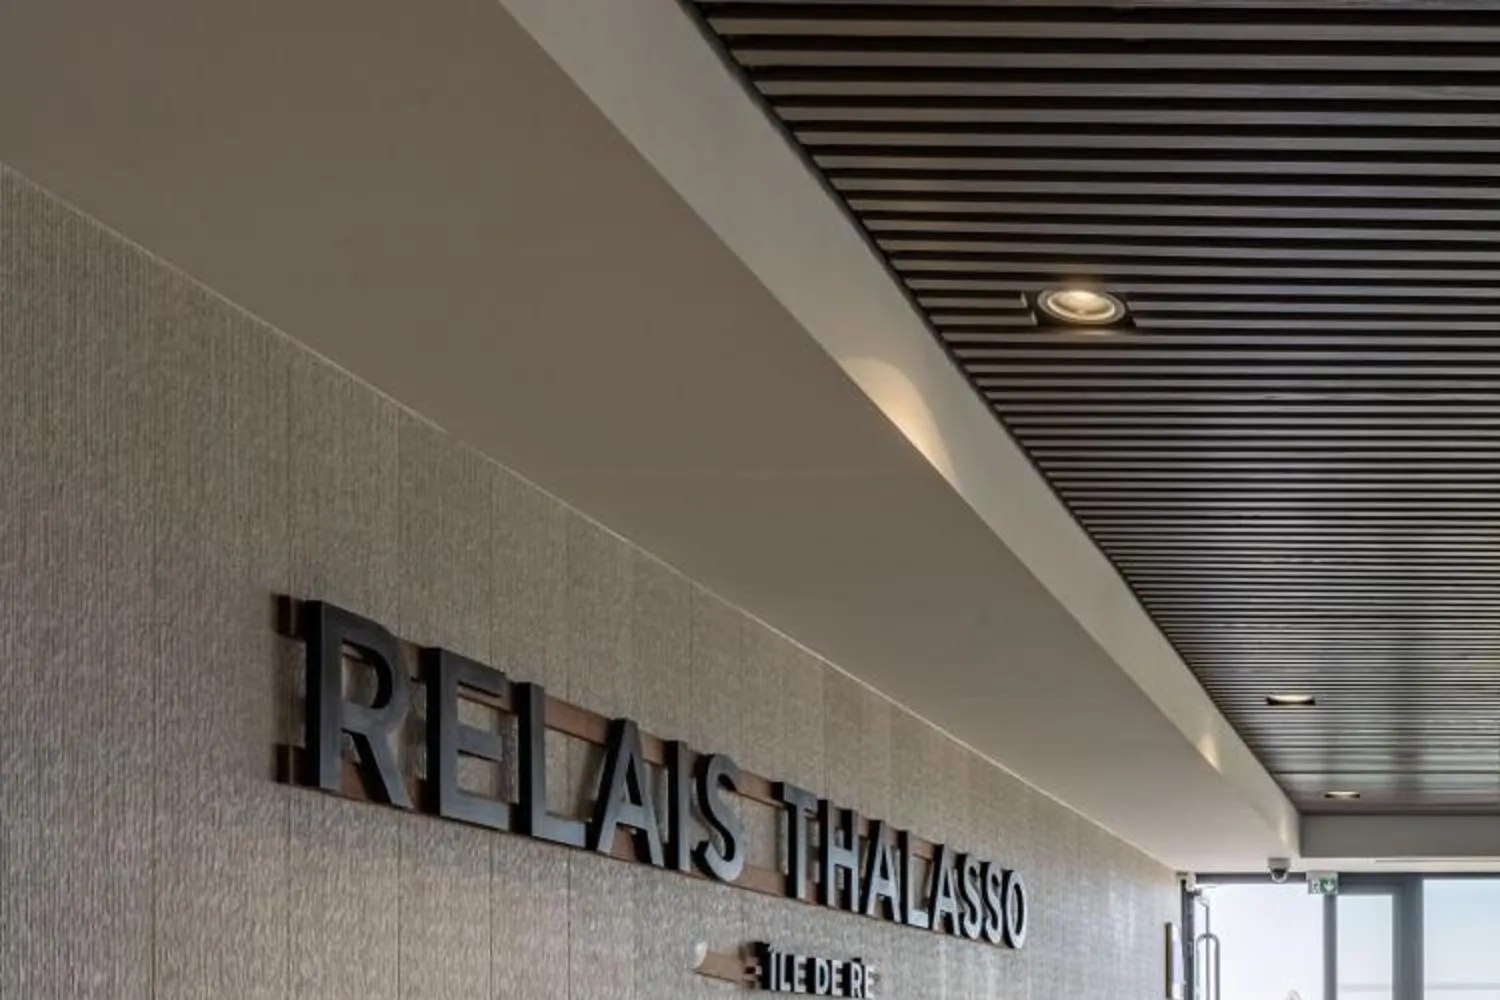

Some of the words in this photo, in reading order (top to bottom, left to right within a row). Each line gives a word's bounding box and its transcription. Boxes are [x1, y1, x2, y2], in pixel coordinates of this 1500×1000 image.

[304, 599, 746, 883] RELAIS
[777, 780, 1029, 949] THALASSO
[814, 956, 843, 996] DE
